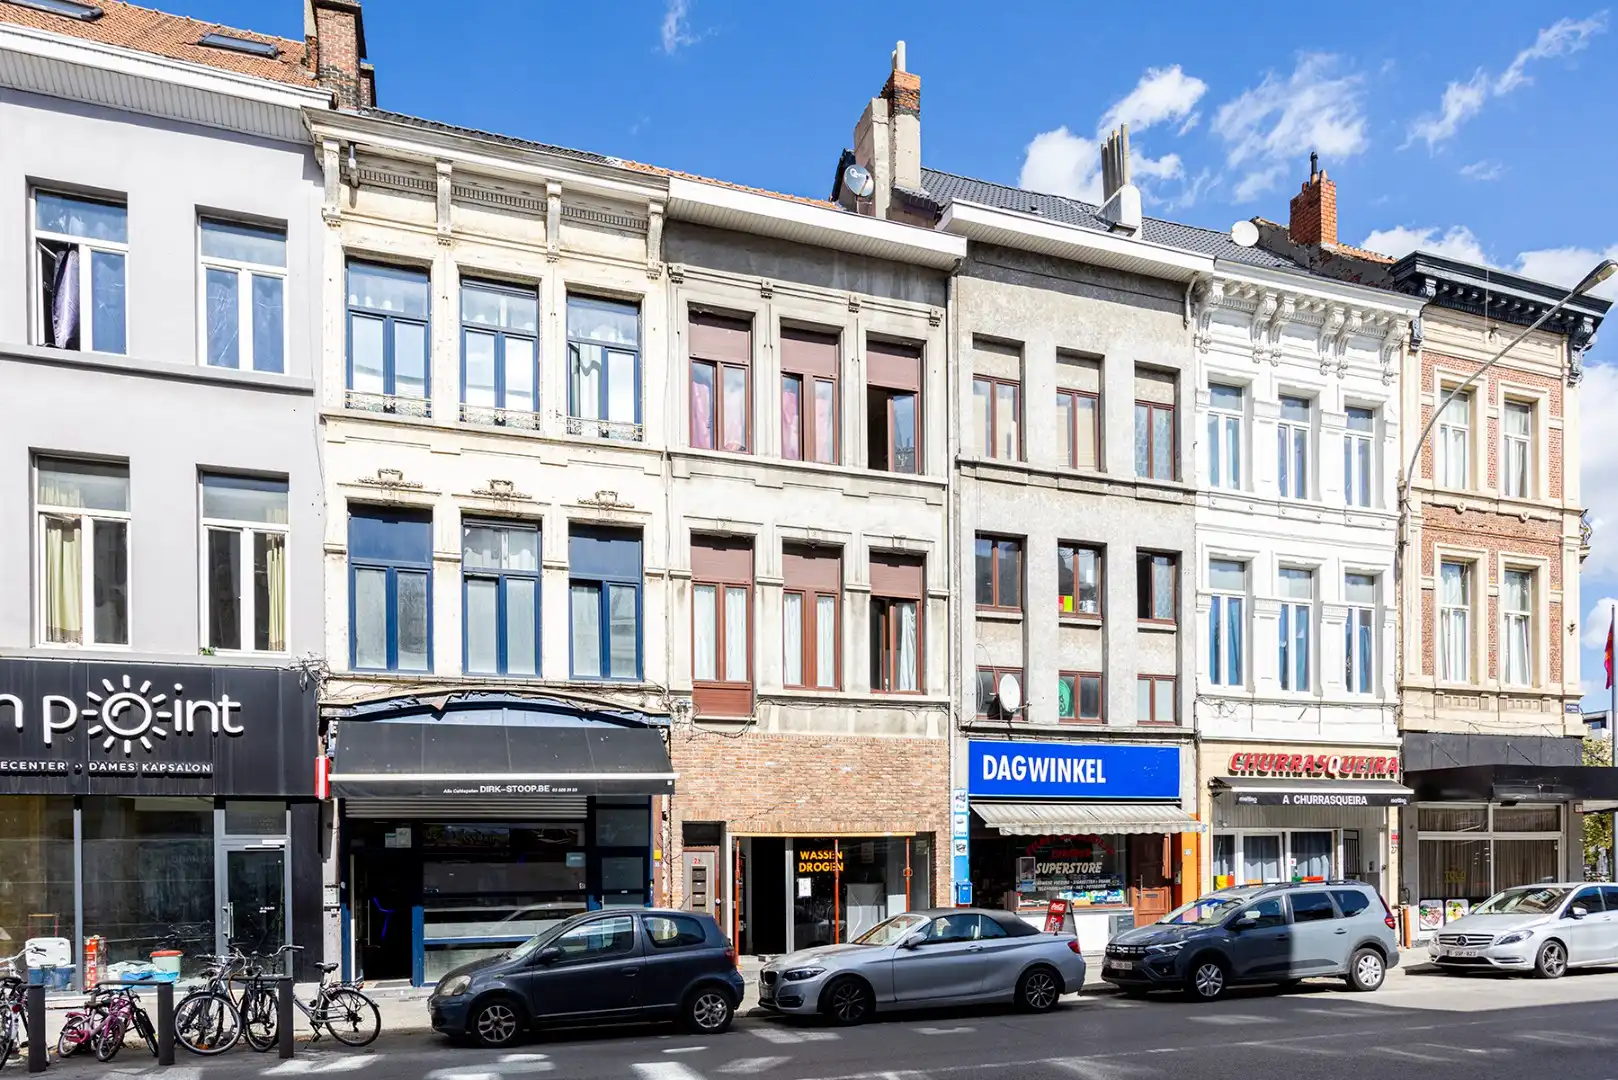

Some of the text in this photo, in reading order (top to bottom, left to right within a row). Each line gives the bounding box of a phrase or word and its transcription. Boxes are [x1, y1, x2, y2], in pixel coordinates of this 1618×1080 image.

[89, 762, 136, 771] DAMES
[142, 763, 211, 772] KAPSALON
[983, 754, 1106, 784] DAGWINKEL
[1230, 752, 1398, 777] CHURRASQUEIRA
[480, 785, 550, 793] DIRK-STOOP.BE
[1282, 794, 1368, 806] A CHURRASQUEIRA
[800, 850, 843, 860] WASSEN
[799, 861, 844, 872] DROGEN
[1035, 862, 1102, 874] SUPERSTORE
